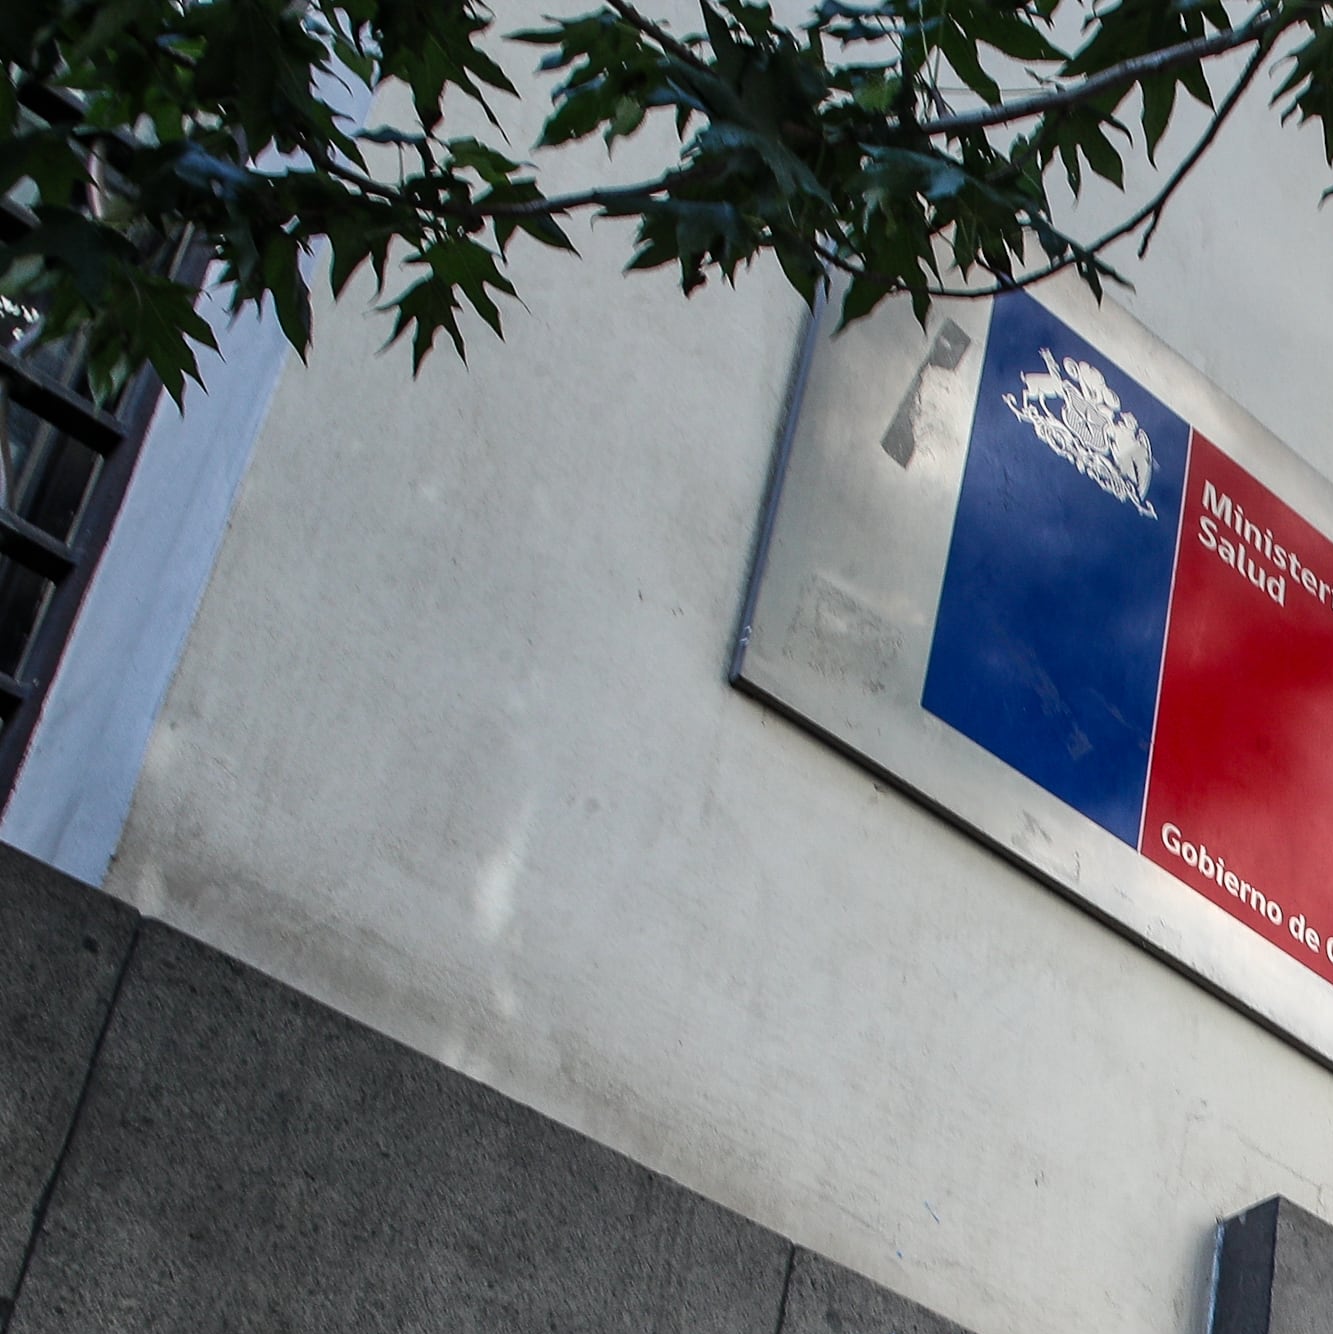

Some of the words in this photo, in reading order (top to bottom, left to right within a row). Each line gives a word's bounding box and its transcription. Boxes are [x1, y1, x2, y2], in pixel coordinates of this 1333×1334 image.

[1198, 515, 1286, 607] Salud
[1161, 822, 1283, 926] Gobierno
[1289, 914, 1320, 953] de
